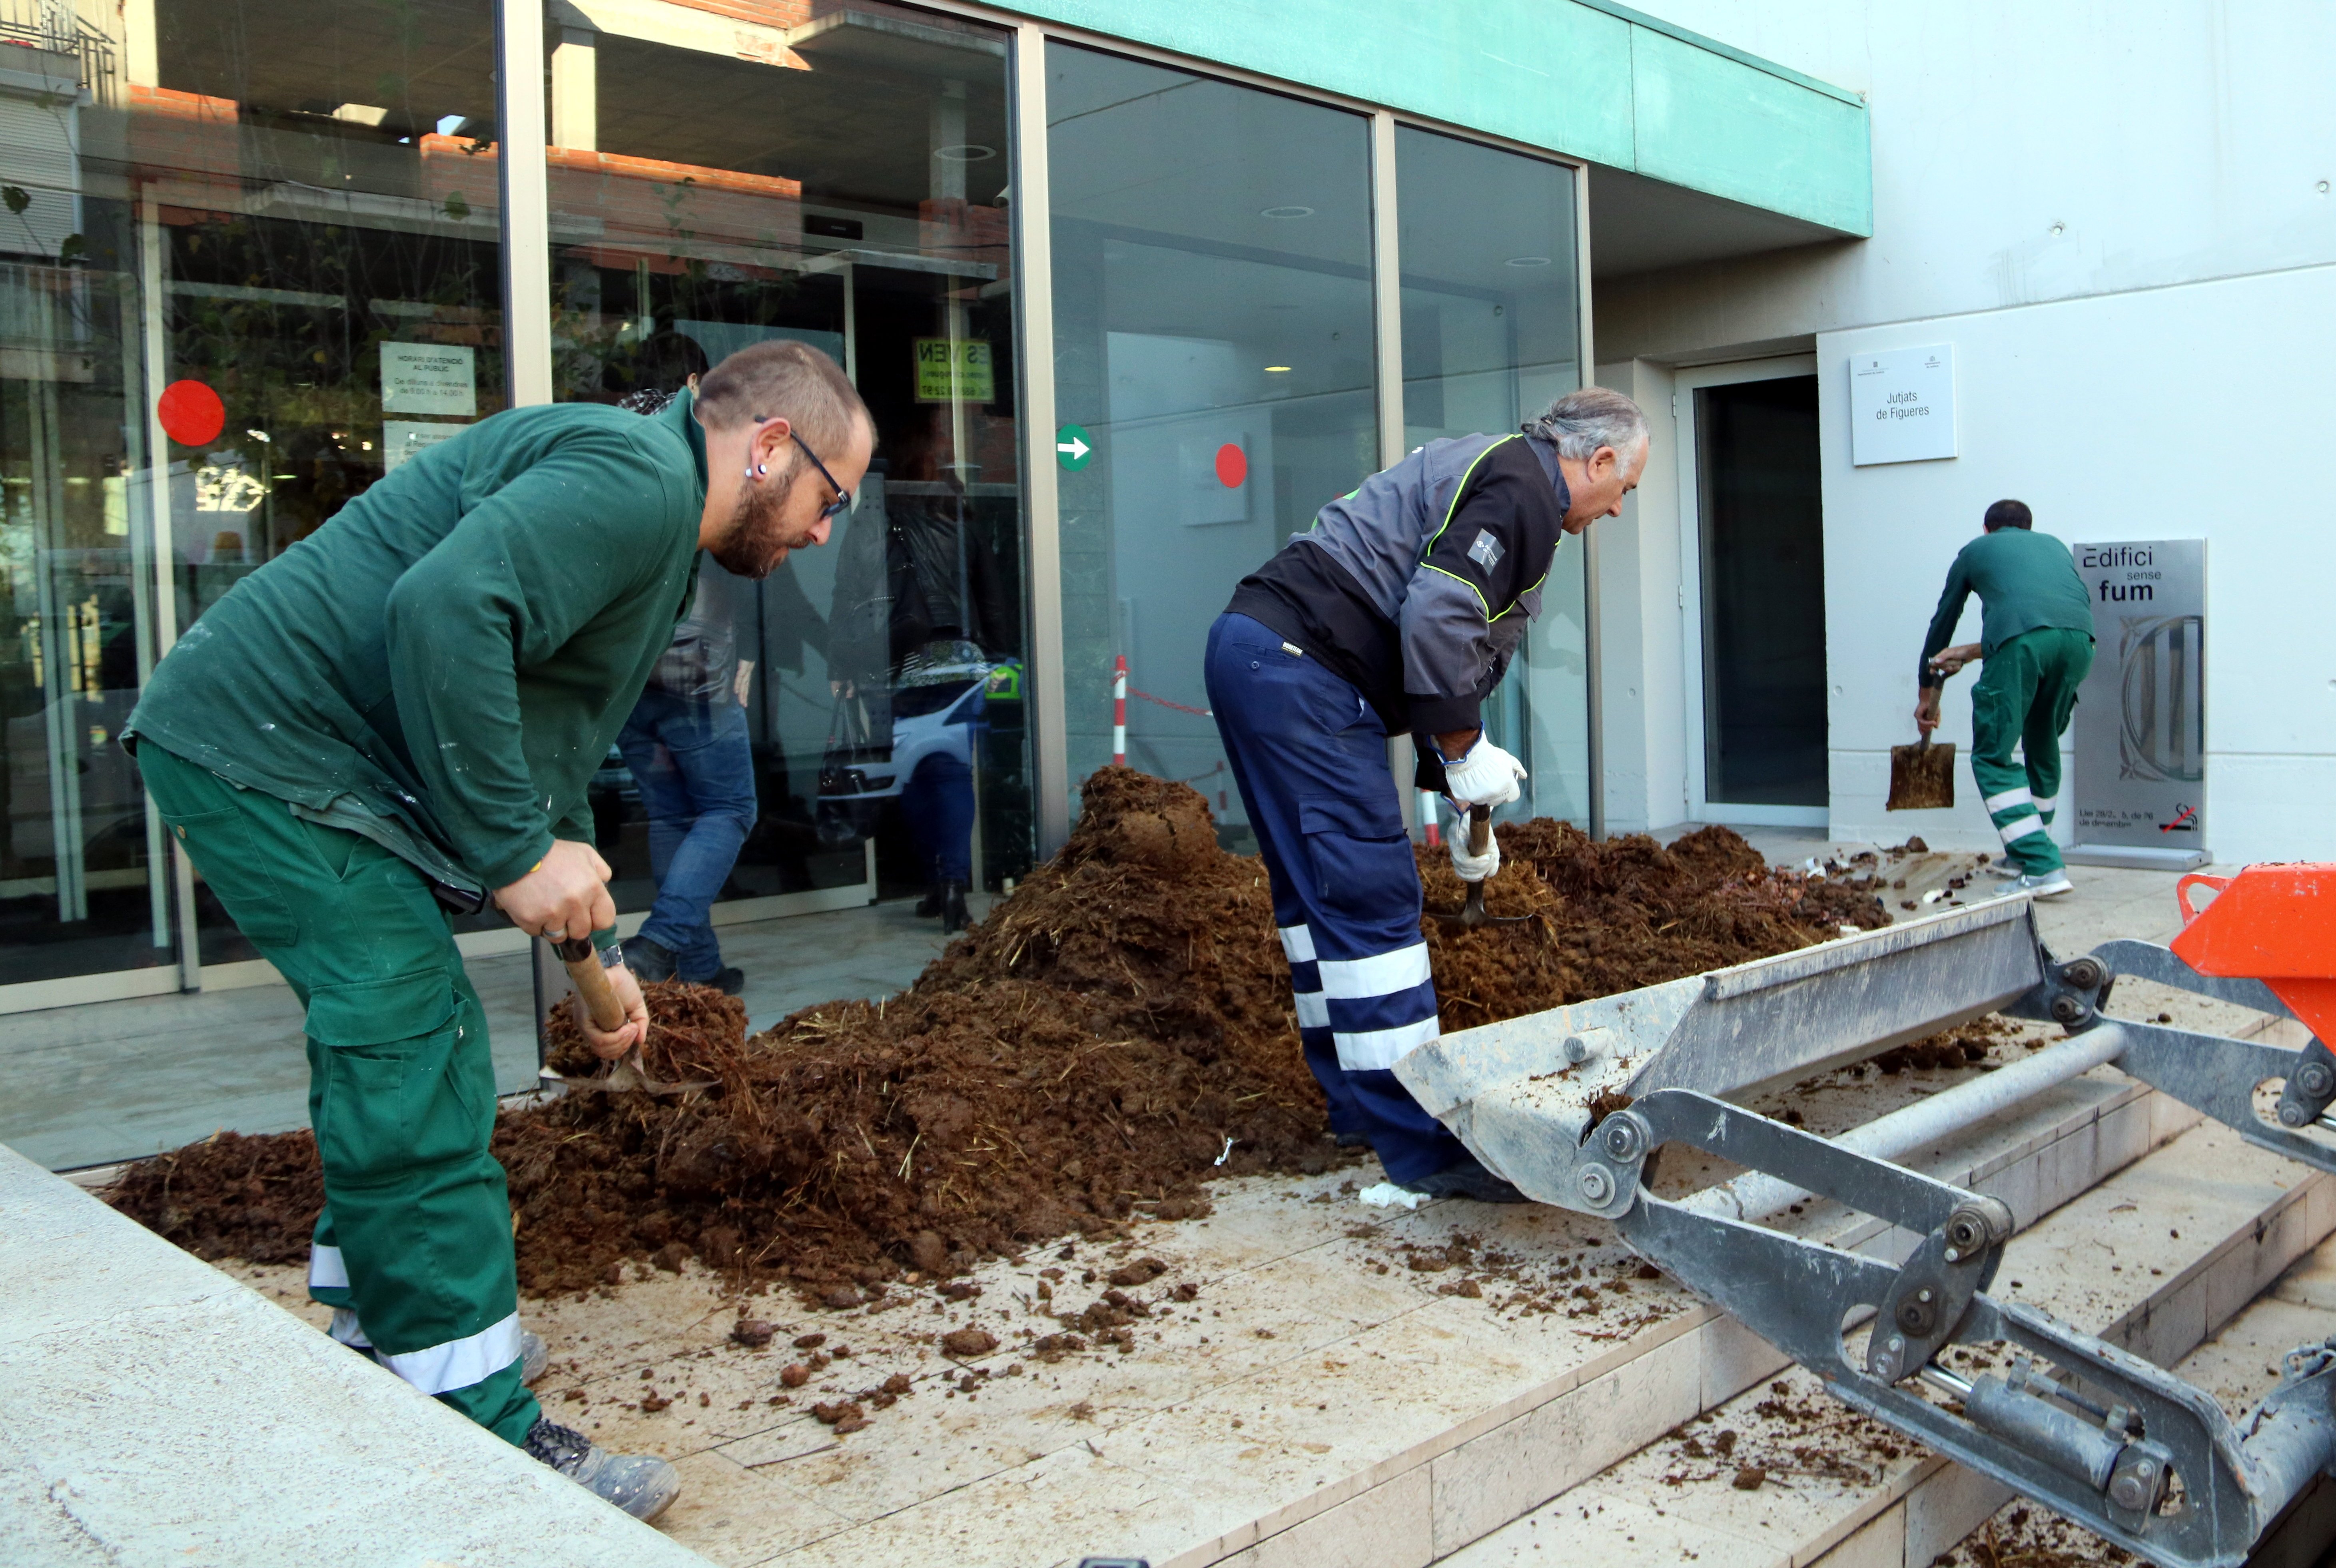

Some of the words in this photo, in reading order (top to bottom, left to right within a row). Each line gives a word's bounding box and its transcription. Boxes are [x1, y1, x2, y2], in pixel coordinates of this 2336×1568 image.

[1887, 391, 1917, 404] Jutjats
[1876, 408, 1887, 420] de
[1890, 406, 1929, 420] Figueres
[2083, 546, 2152, 568] Edifici
[2127, 572, 2162, 580] sense
[2099, 580, 2153, 601] fum
[1283, 642, 1303, 654] WORKTEAM
